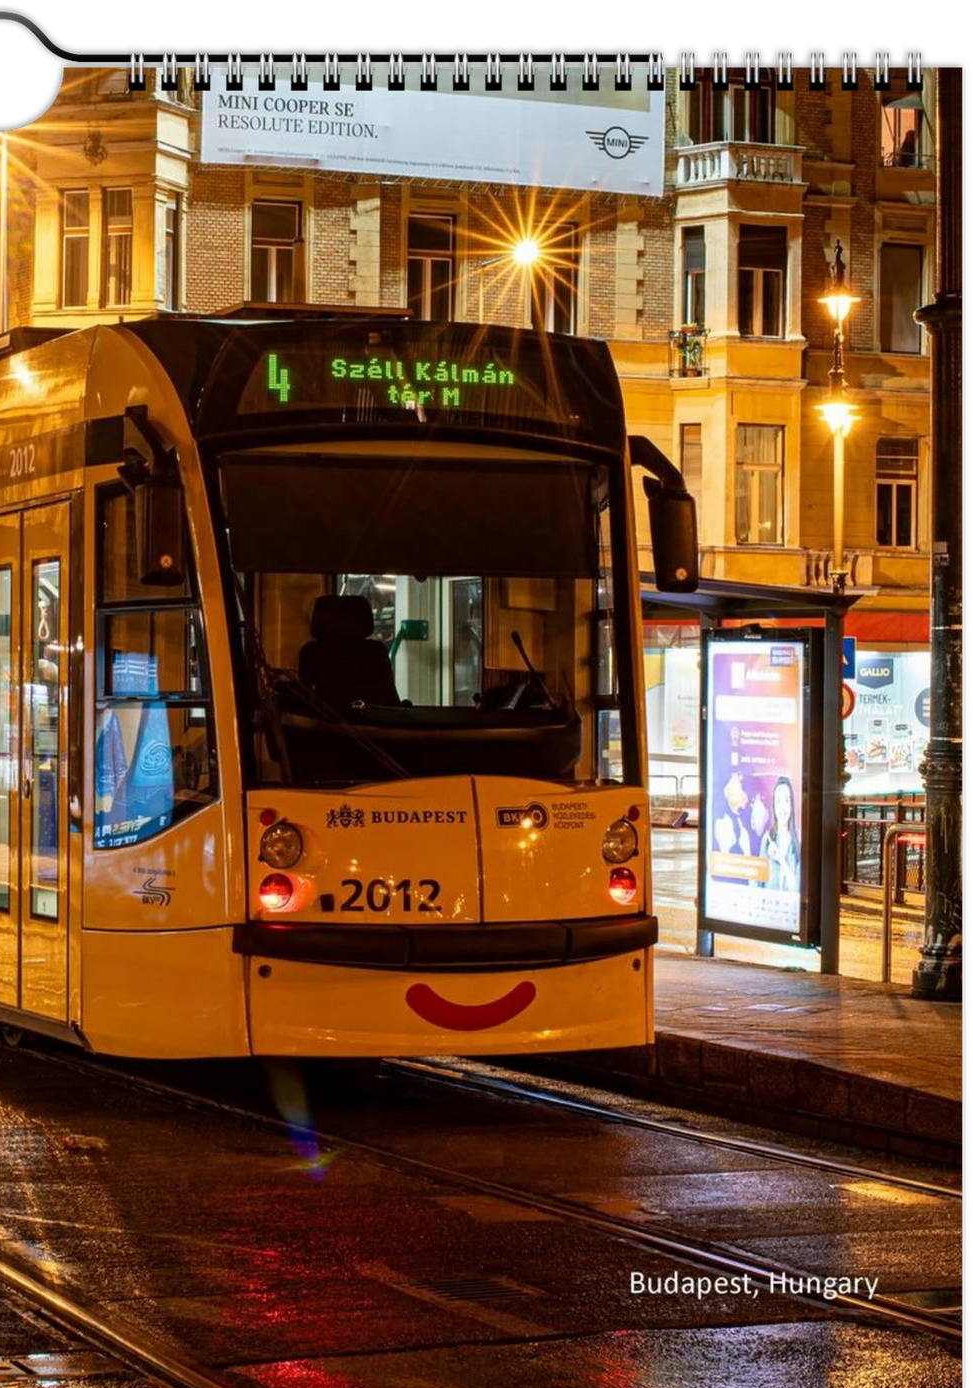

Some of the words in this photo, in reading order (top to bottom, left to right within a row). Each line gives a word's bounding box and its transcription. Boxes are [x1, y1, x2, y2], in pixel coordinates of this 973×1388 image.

[218, 94, 258, 111] MINI
[263, 97, 329, 115] COOPER
[334, 101, 354, 118] SE
[218, 114, 303, 133] RESOLUTE
[308, 119, 379, 139] EDITION.
[606, 137, 628, 149] MINI
[268, 354, 291, 402] 4
[331, 358, 404, 380] Széll
[415, 361, 515, 385] Kálmán
[388, 383, 431, 405] tér
[442, 387, 460, 406] M
[9, 443, 36, 478] 2012
[860, 667, 891, 677] GALLIO
[371, 810, 468, 824] BUDAPEST
[340, 878, 442, 912] 2012
